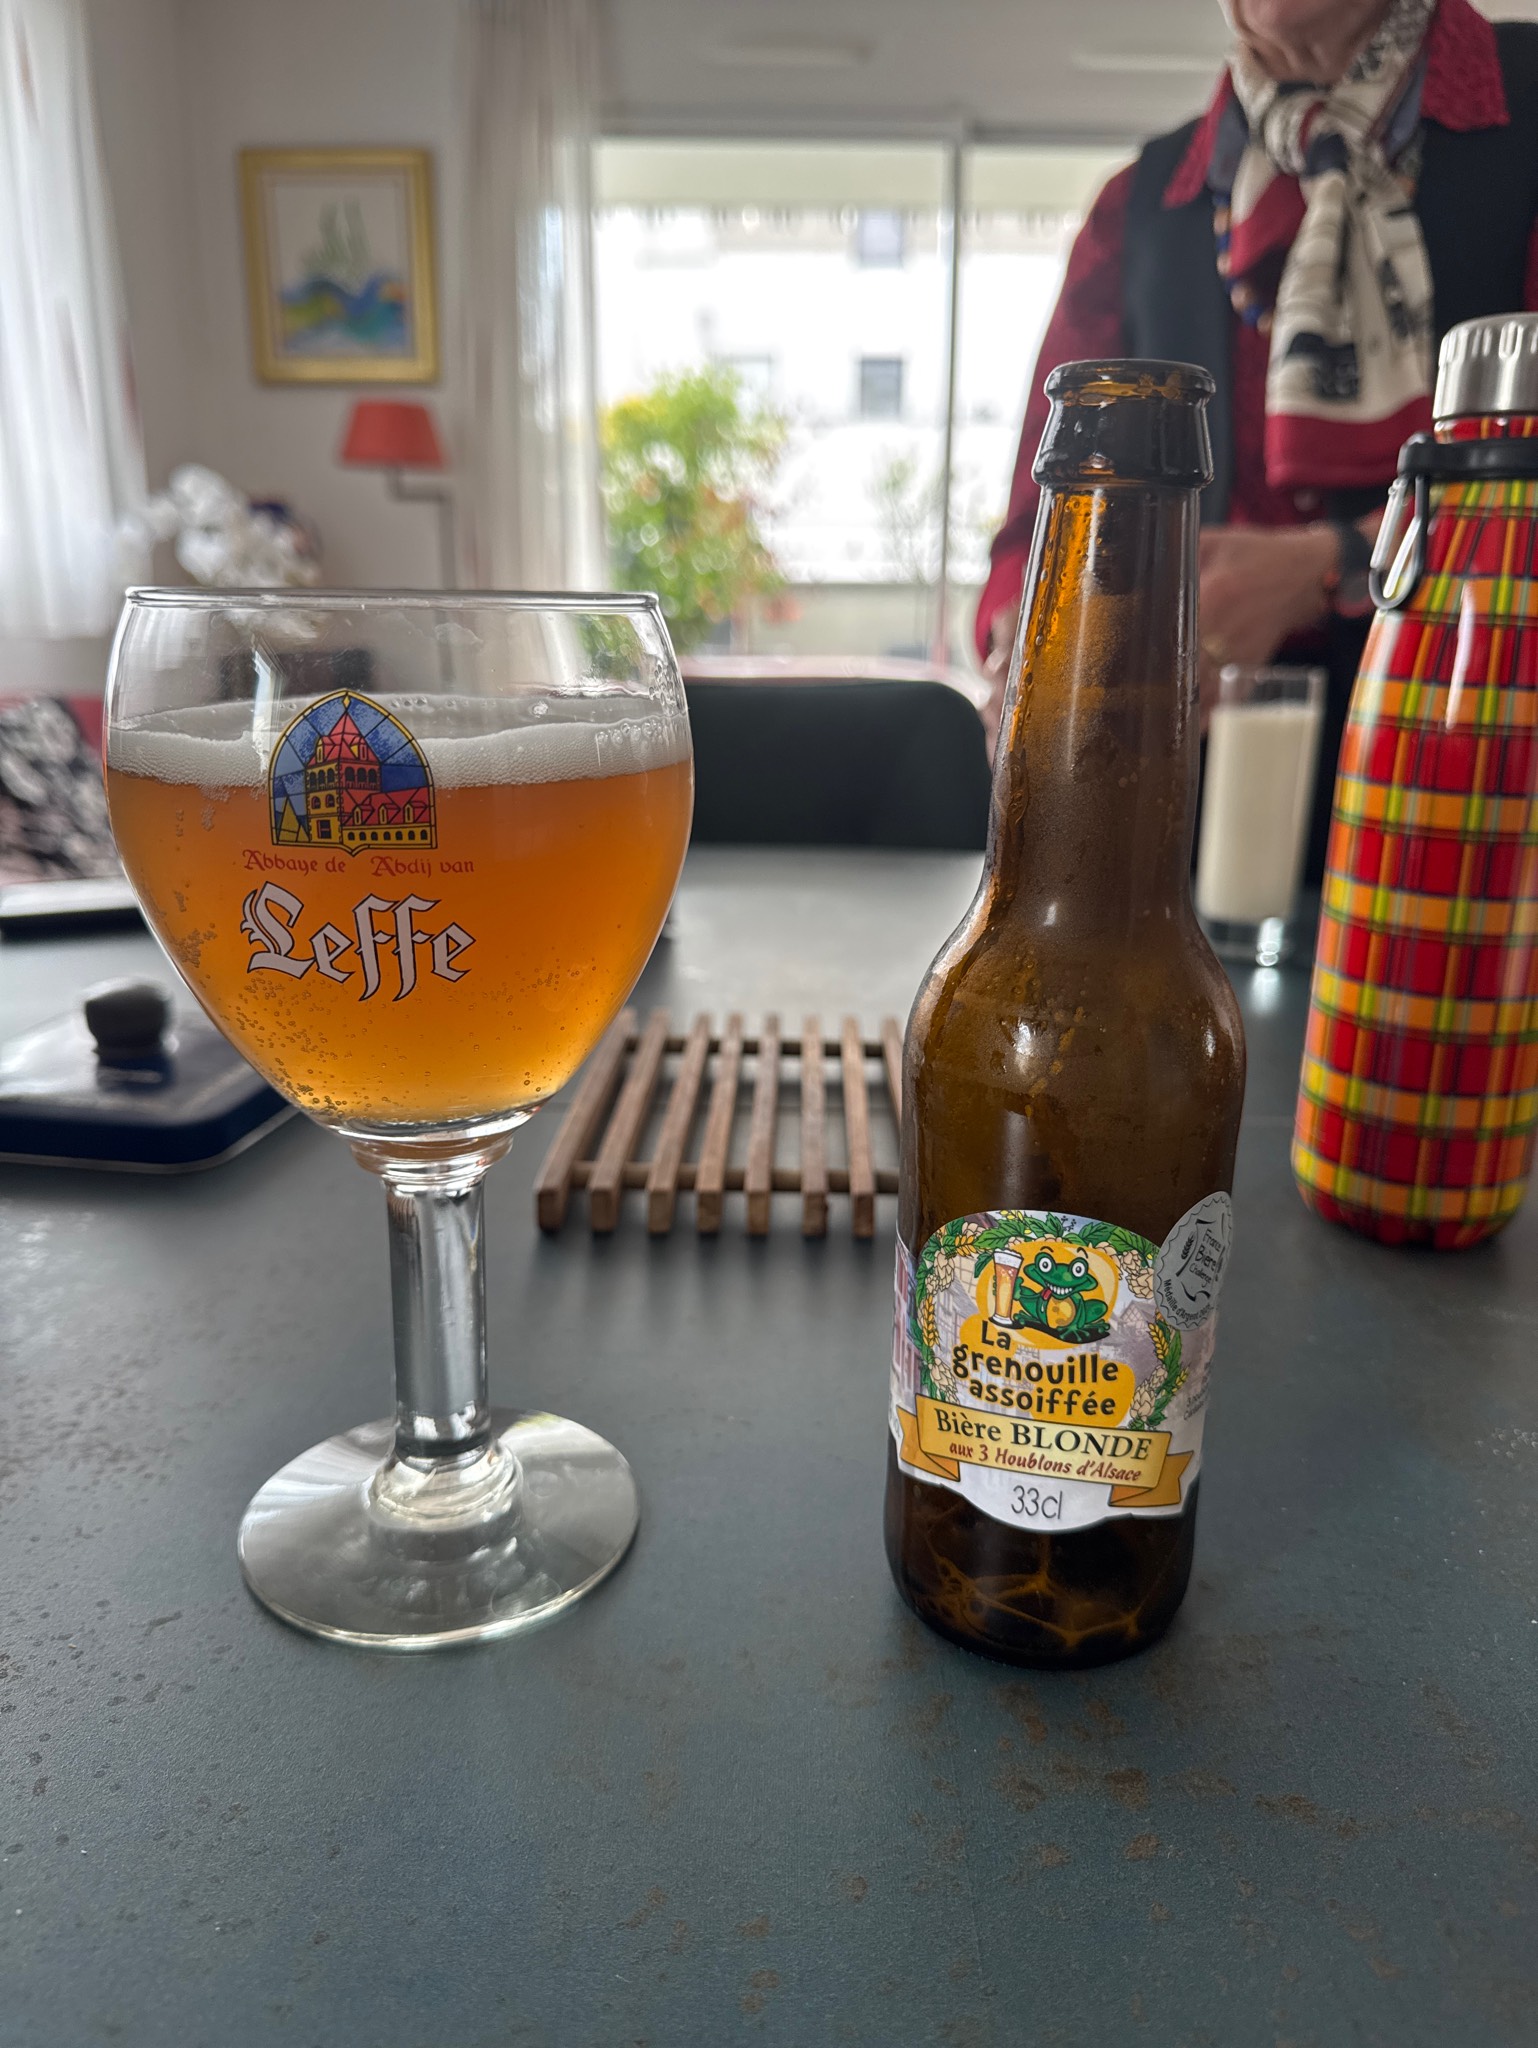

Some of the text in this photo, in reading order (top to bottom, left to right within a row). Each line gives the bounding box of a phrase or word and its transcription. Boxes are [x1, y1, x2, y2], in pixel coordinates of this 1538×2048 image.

[243, 849, 346, 876] Abbaye de
[371, 856, 475, 878] Abdij van
[240, 881, 477, 1002] Leffe
[1164, 1278, 1178, 1312] Médaille
[981, 1320, 1011, 1350] La
[952, 1343, 1118, 1384] grenouille
[969, 1378, 1116, 1416] assoiffée
[934, 1407, 1001, 1442] Bière
[1010, 1422, 1153, 1461] BLONDE
[949, 1441, 1142, 1482] aux 3 Houblons d'Alsace
[1010, 1484, 1063, 1520] 33cl
